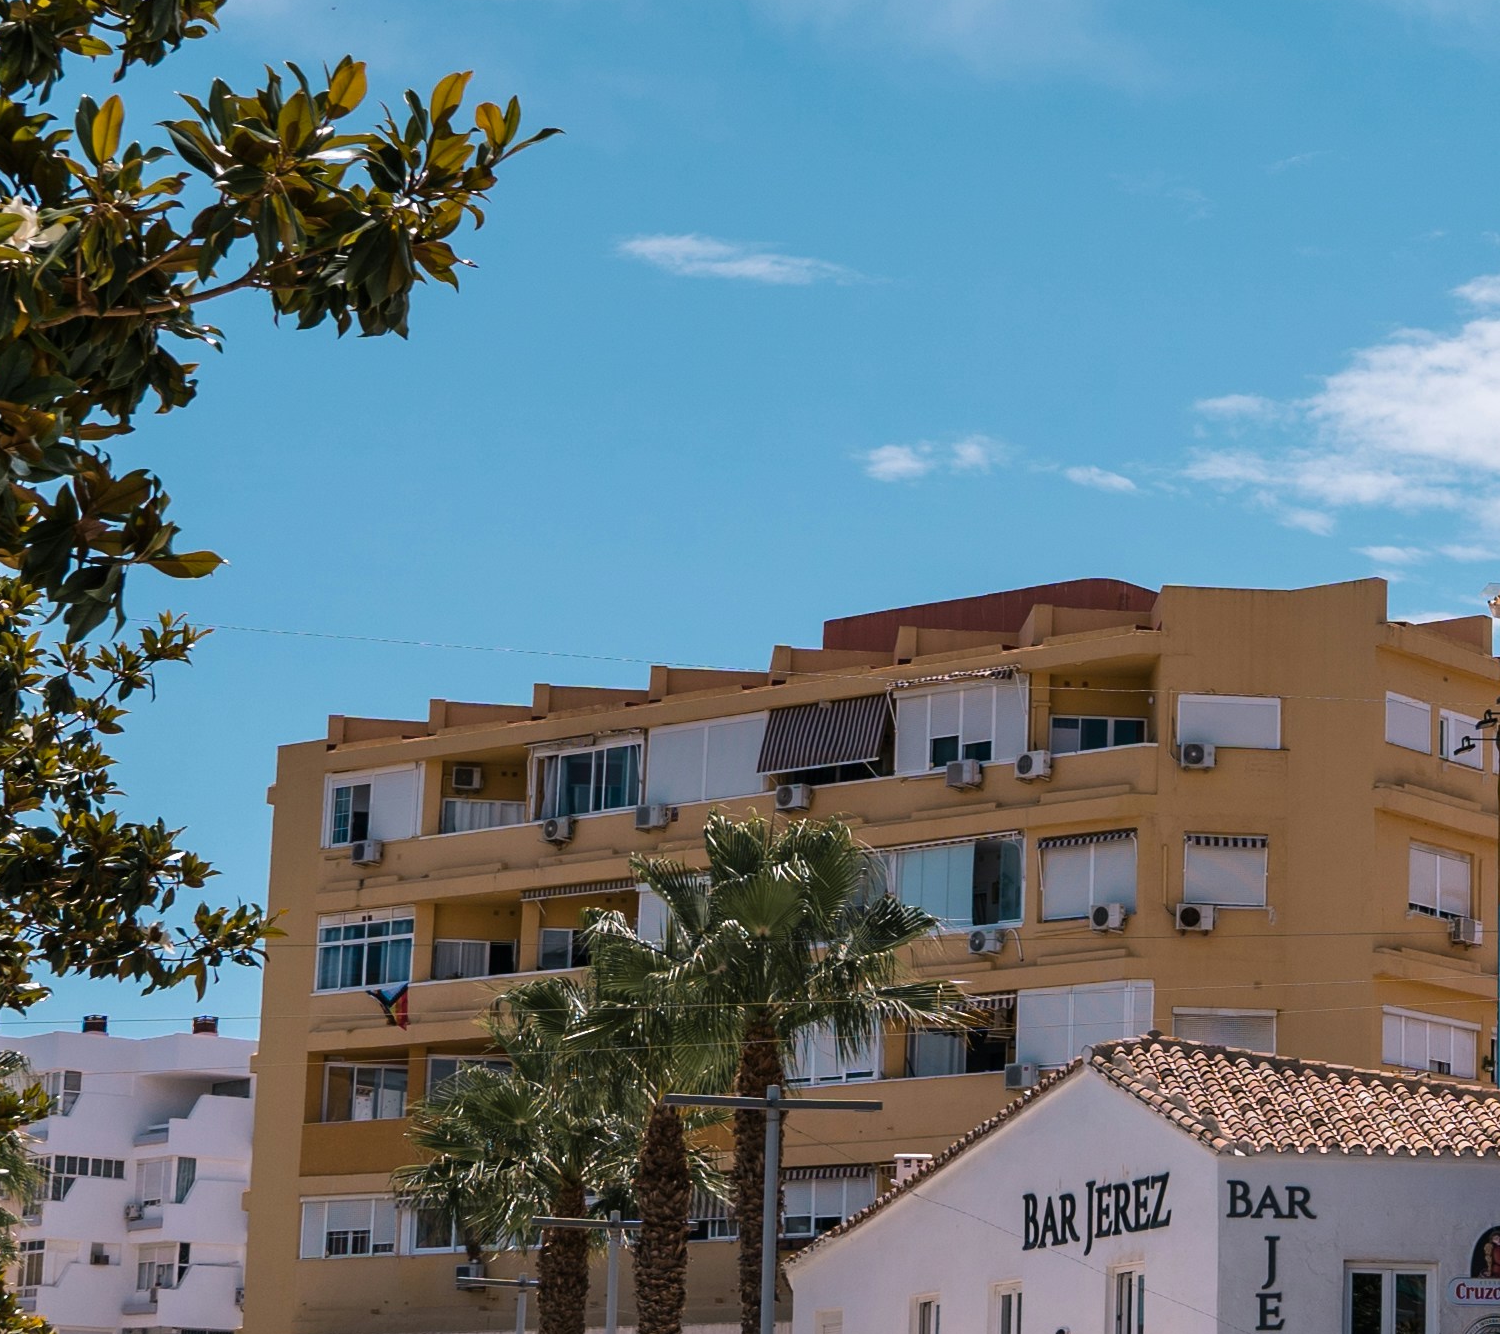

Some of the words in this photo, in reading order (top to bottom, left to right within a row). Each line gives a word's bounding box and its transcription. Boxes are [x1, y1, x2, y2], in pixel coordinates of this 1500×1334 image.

[1022, 1193, 1080, 1250] BAR
[1083, 1172, 1172, 1256] JEREZ
[1226, 1179, 1317, 1219] BAR
